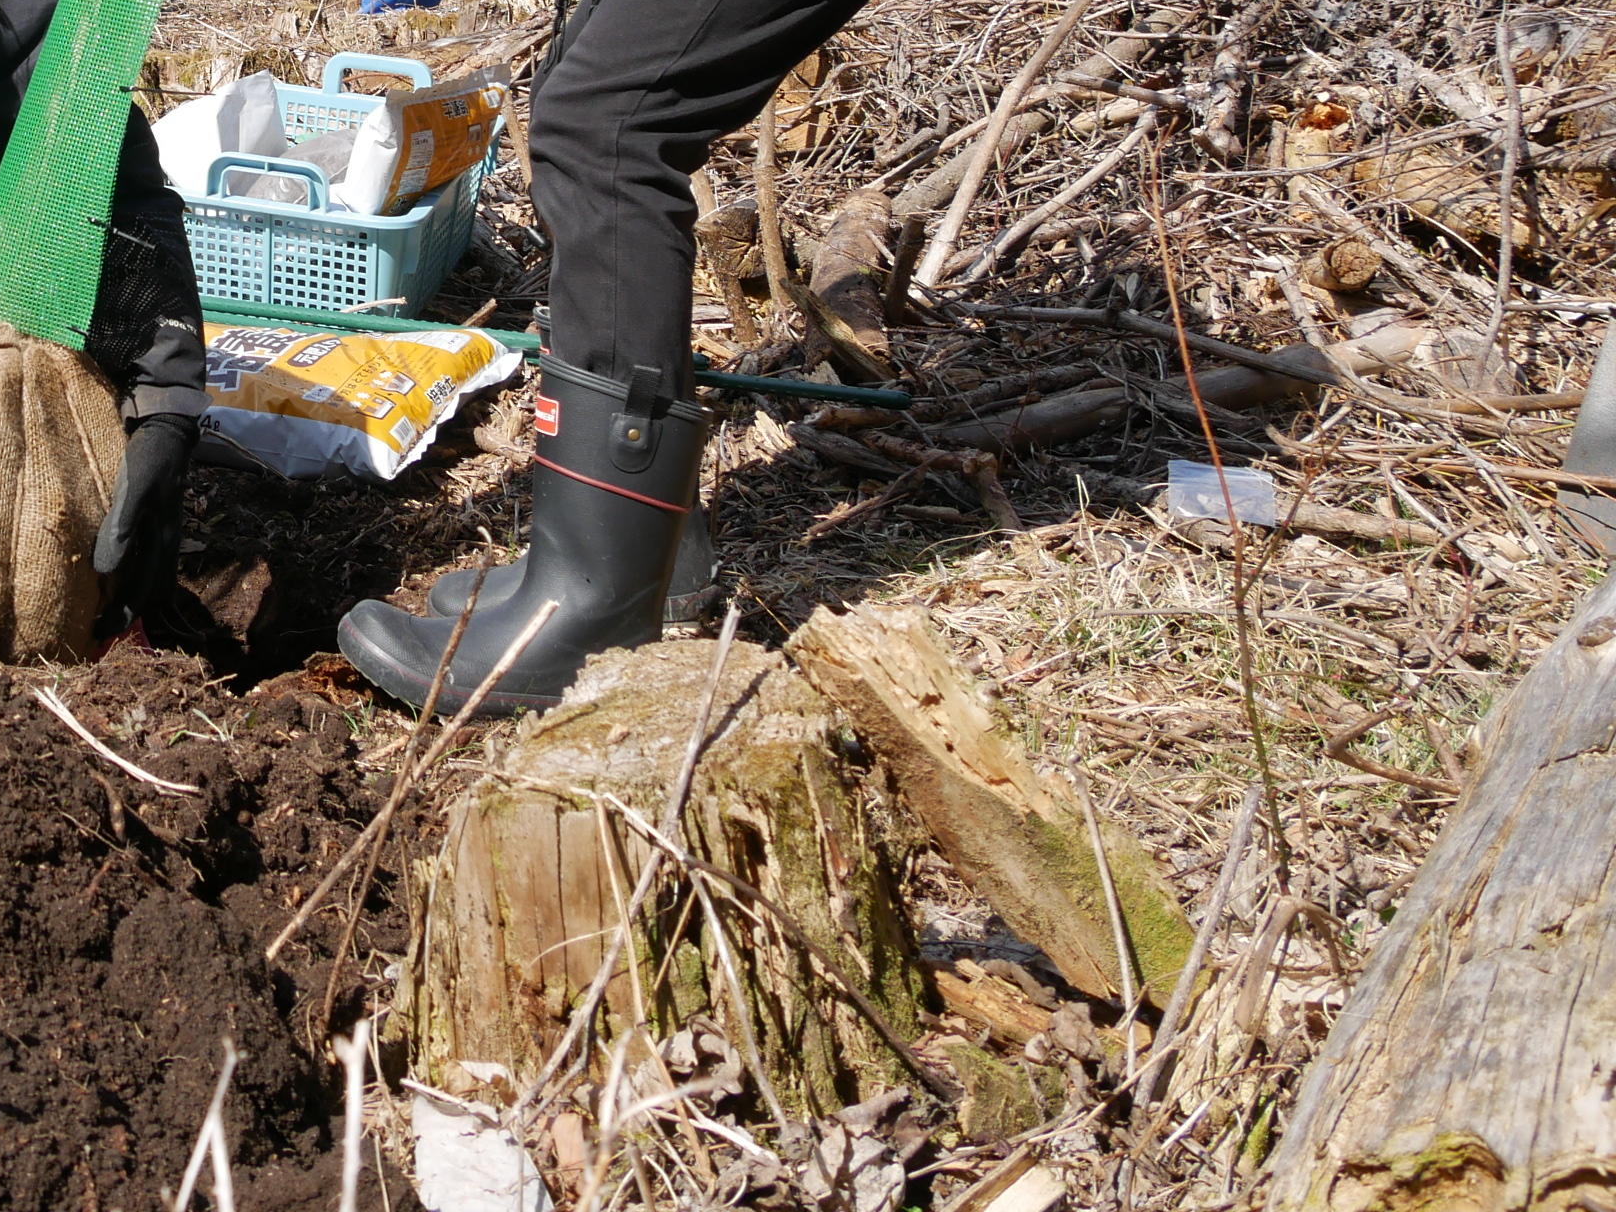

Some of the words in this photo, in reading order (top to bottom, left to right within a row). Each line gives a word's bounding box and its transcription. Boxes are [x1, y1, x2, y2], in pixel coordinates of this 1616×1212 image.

[296, 338, 341, 365] 元肥入り
[426, 377, 455, 405] 培養土
